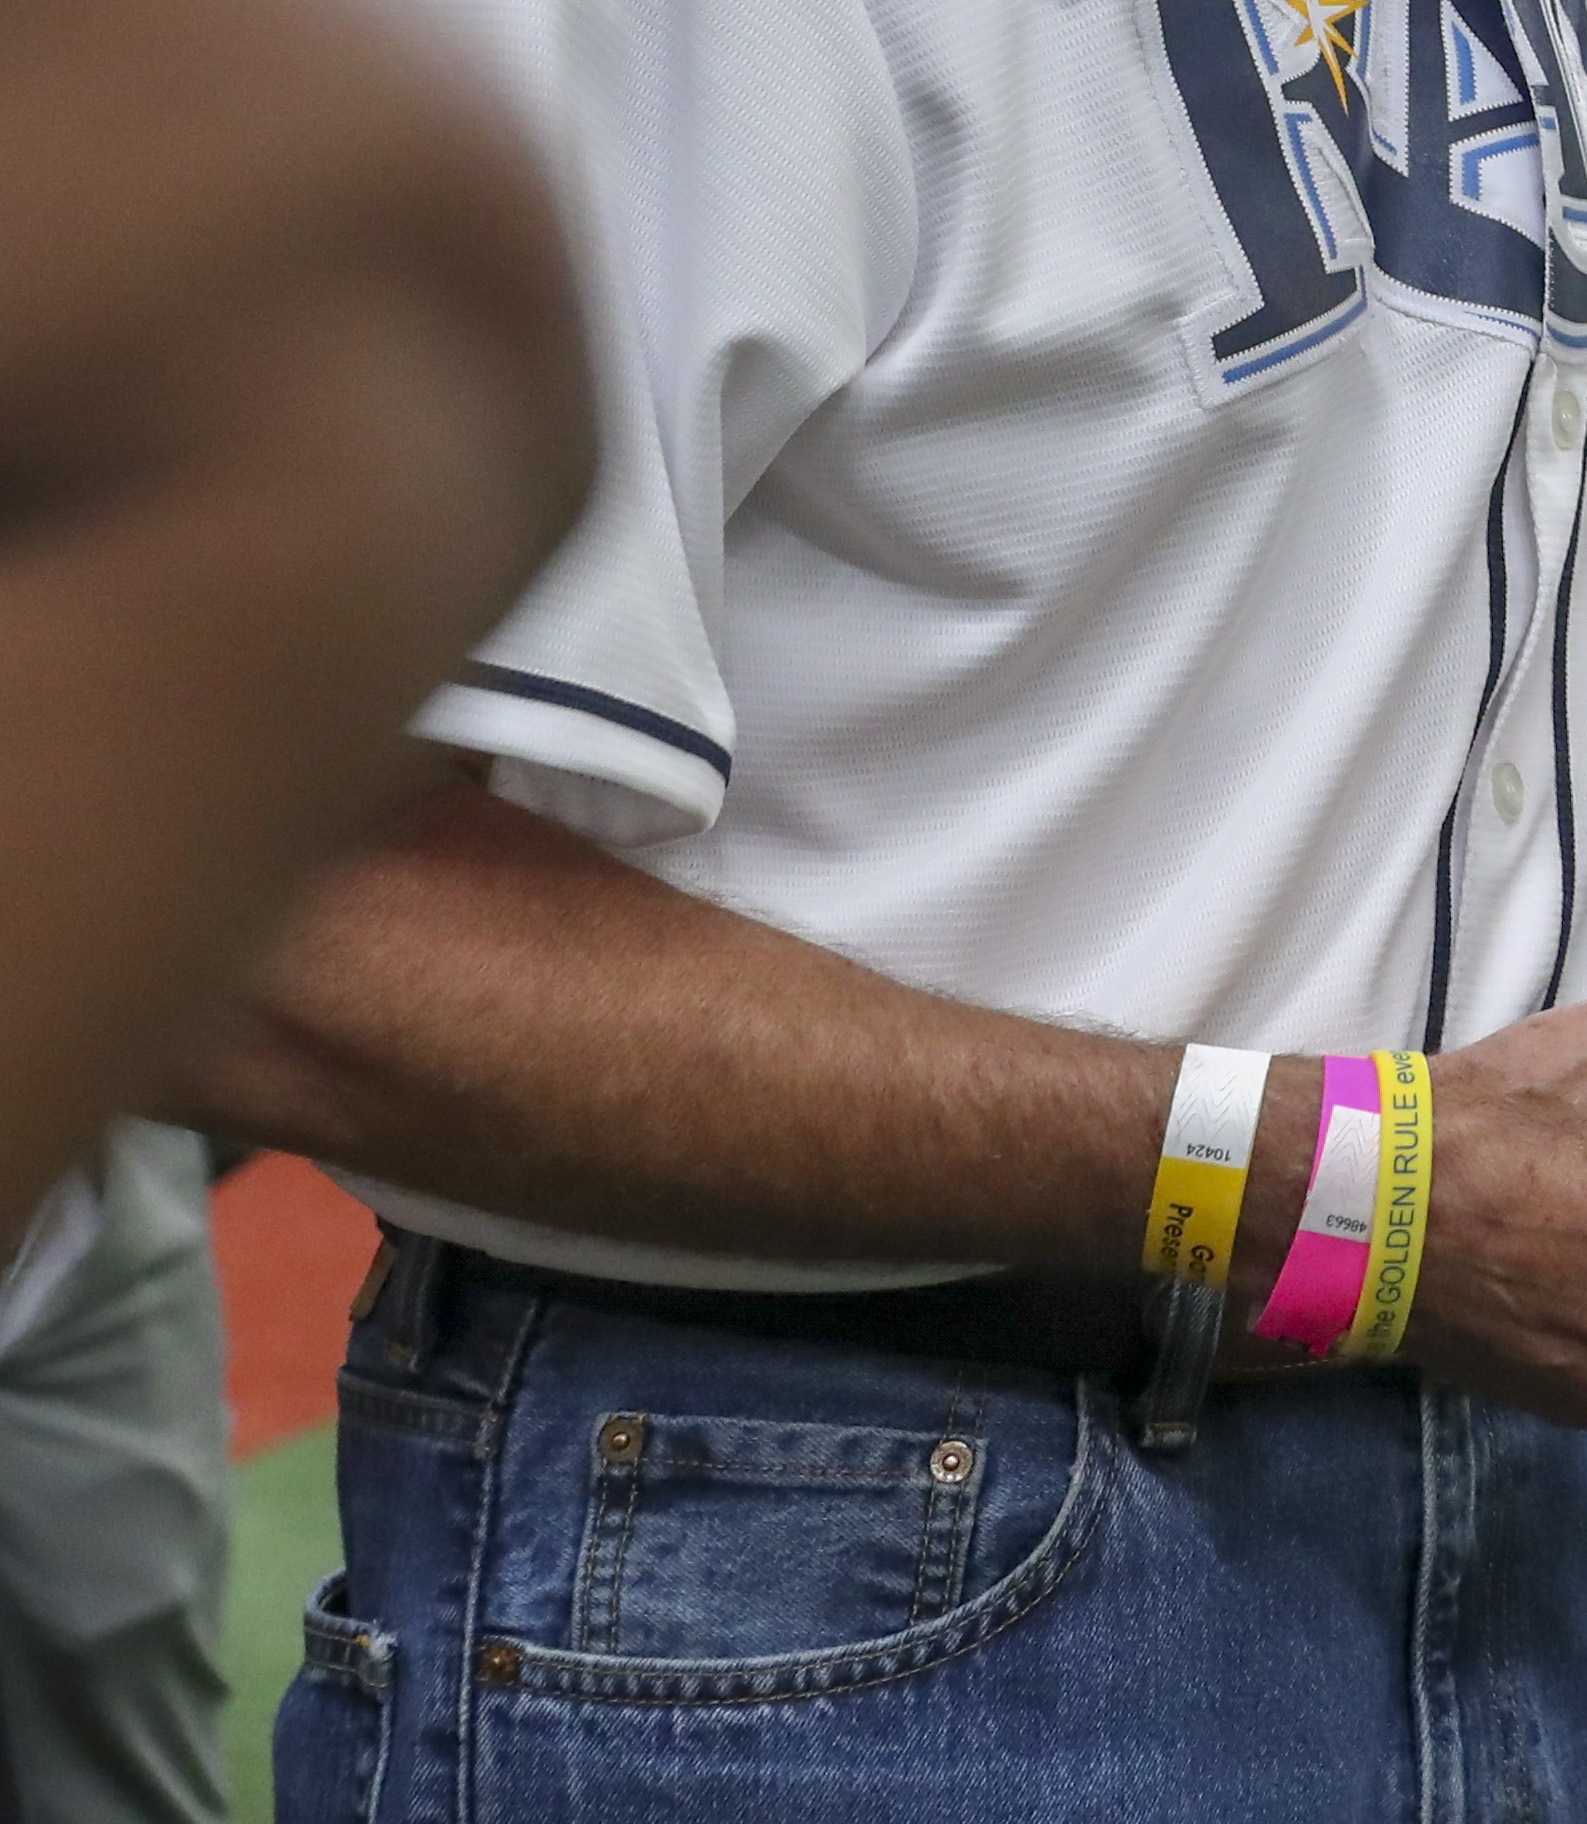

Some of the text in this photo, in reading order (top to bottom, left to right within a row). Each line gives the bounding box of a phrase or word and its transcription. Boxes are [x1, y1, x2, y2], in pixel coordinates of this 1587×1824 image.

[1186, 1142, 1232, 1162] 10424
[1392, 1092, 1420, 1175] RULE
[1375, 1184, 1416, 1305] GOLDEN
